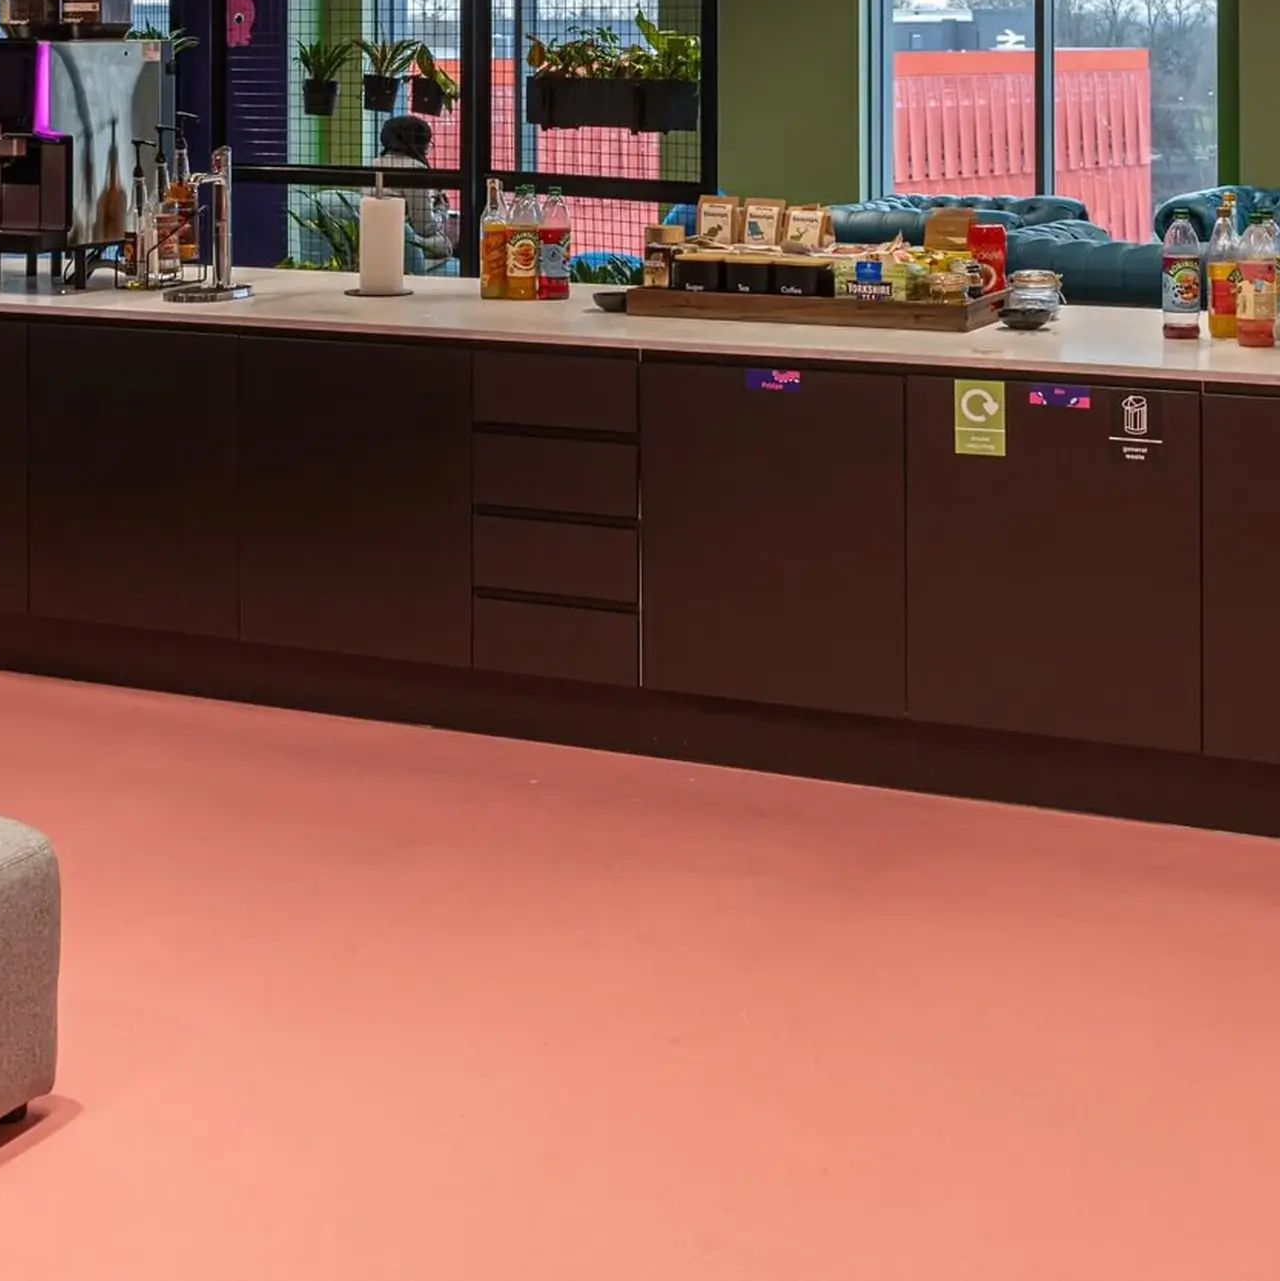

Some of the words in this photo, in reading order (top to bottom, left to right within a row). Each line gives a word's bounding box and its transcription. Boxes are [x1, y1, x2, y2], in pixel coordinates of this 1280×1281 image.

[738, 283, 750, 292] Tea
[780, 285, 802, 294] Coffee
[847, 282, 890, 295] YORKSHIRE
[1122, 445, 1148, 454] general
